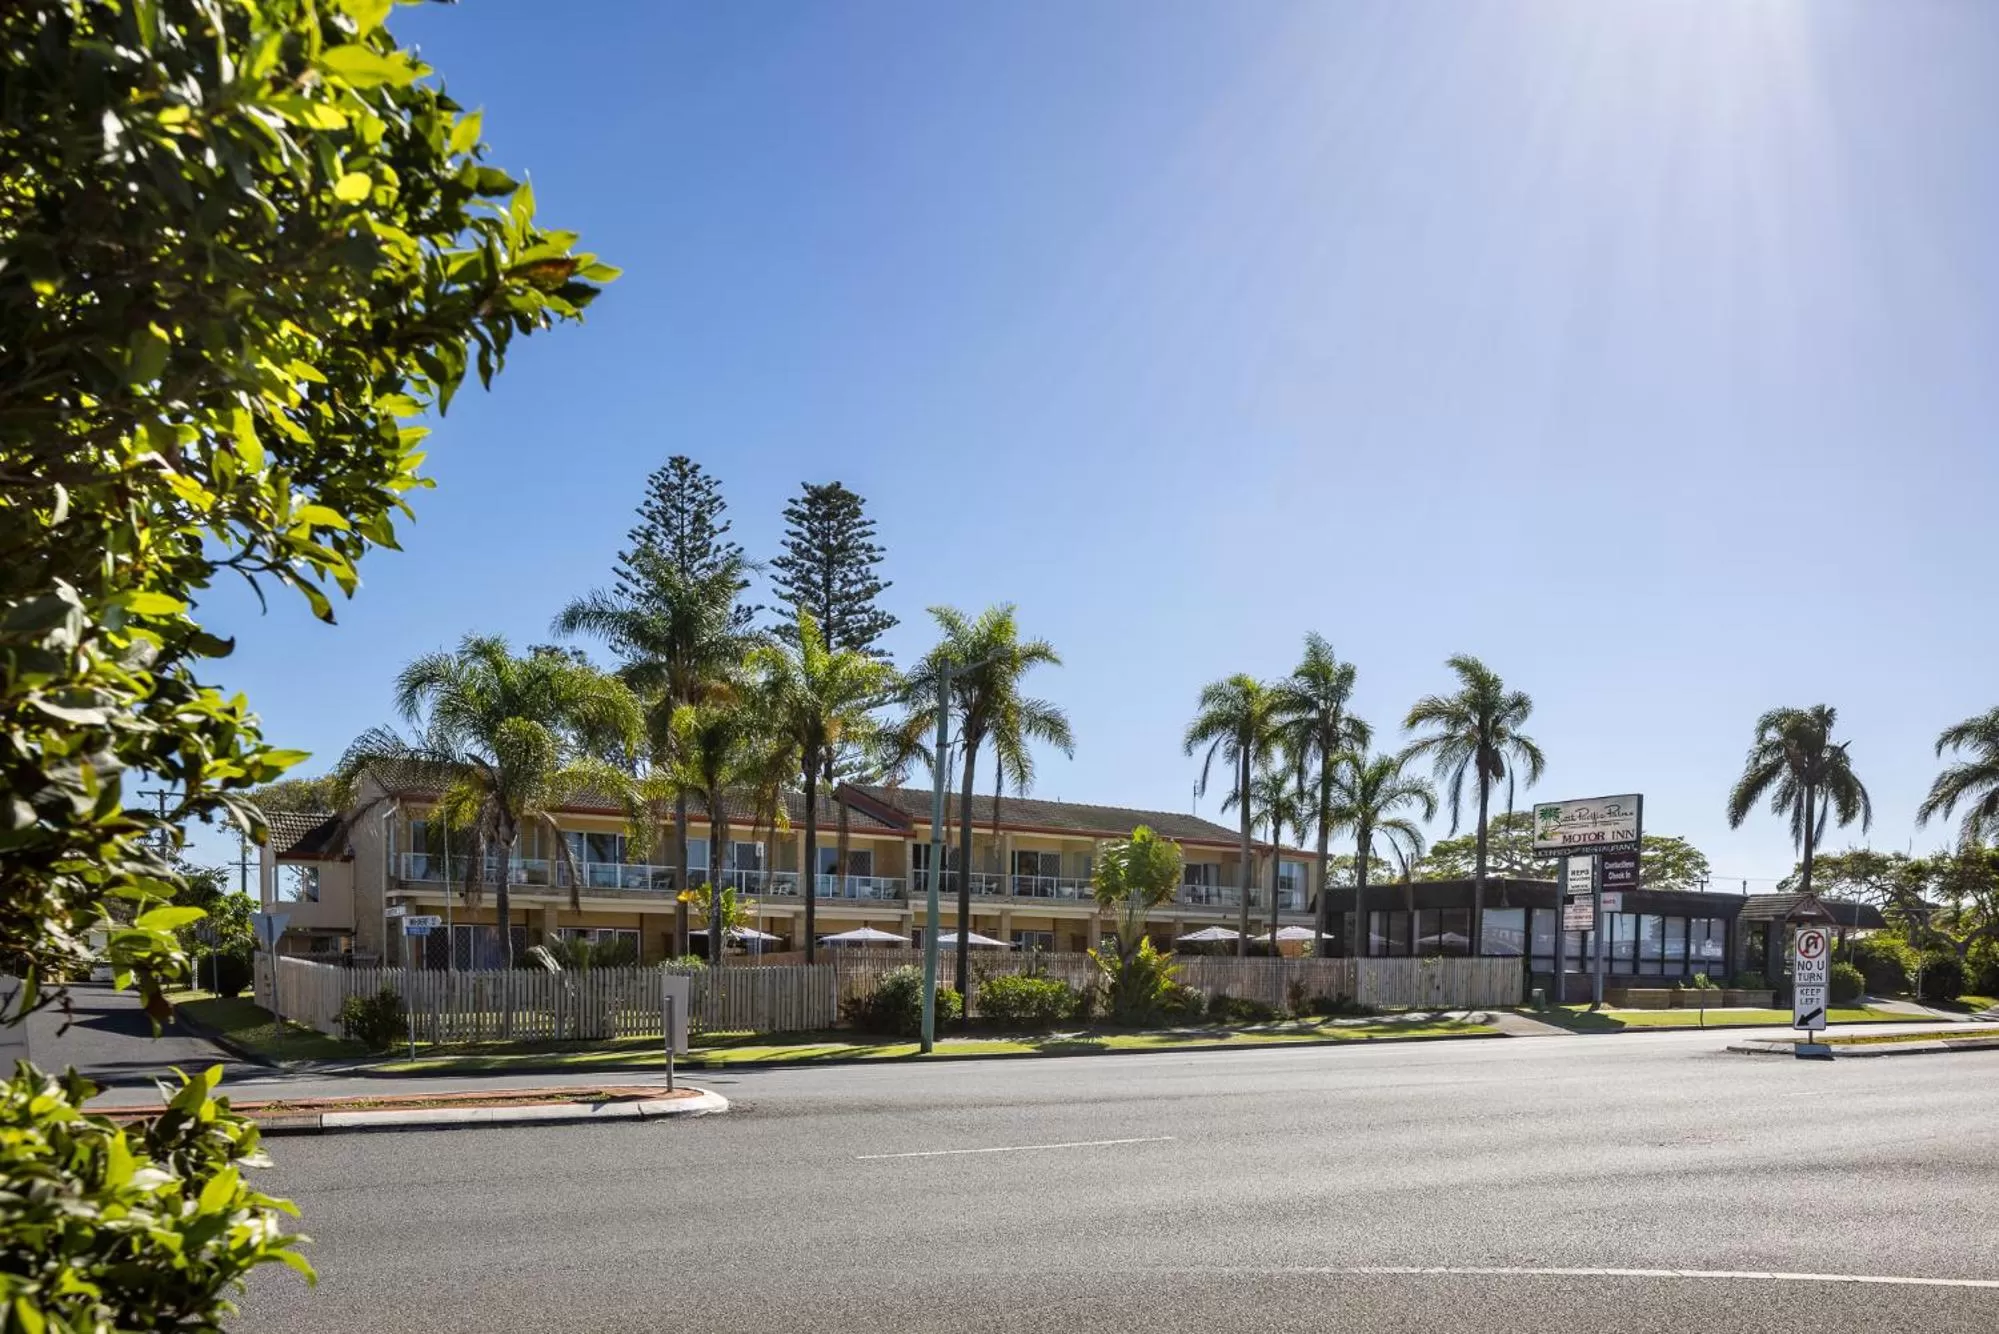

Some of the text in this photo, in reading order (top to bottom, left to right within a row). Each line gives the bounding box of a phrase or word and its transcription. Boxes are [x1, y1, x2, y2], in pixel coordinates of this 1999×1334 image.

[1562, 828, 1635, 844] MOTOR INN
[1797, 960, 1824, 971] NO U
[1798, 972, 1823, 982] TURN
[1799, 988, 1821, 997] KEEP
[1799, 997, 1820, 1005] LEFT
